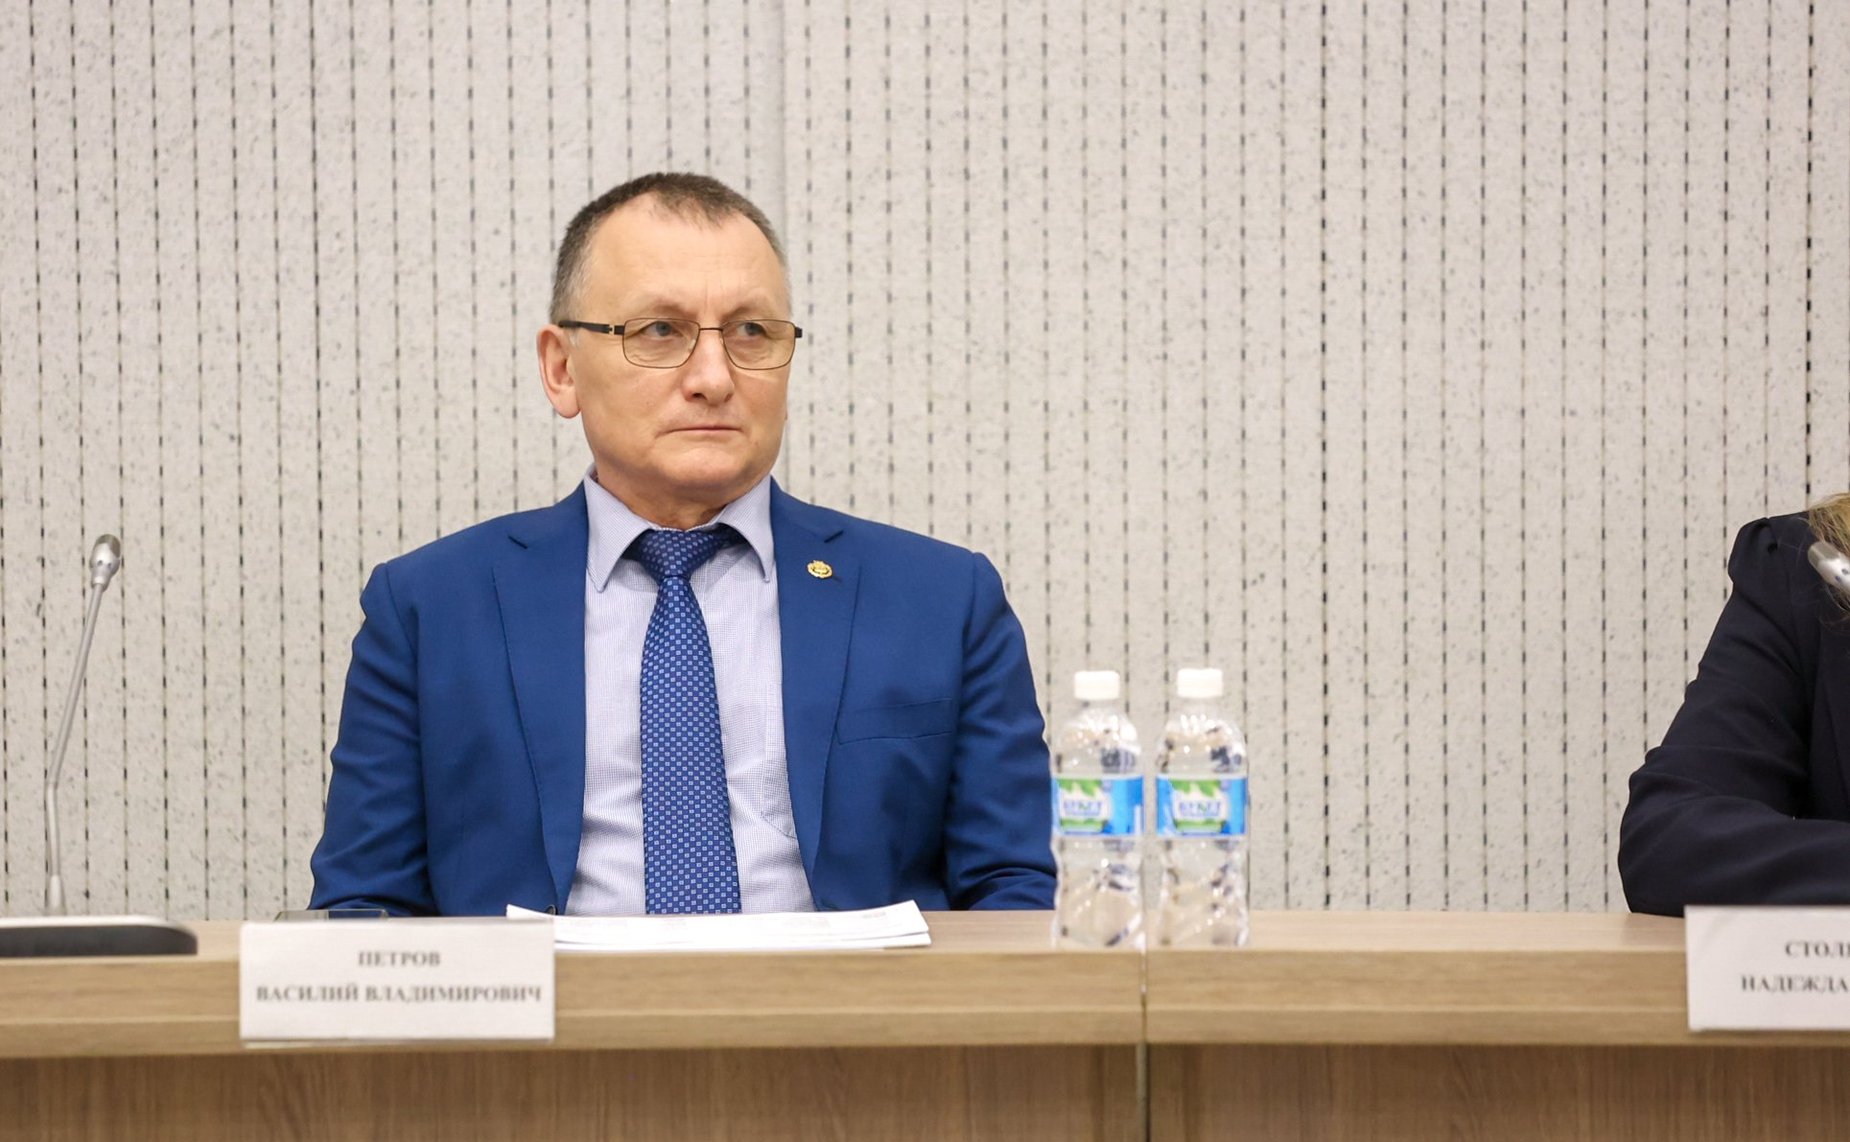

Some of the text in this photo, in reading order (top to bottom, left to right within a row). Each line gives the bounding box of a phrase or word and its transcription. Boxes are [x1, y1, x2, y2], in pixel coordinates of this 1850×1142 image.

[1784, 941, 1850, 958] СТОЛ
[357, 951, 441, 967] ПЕТРОВ
[256, 983, 541, 1003] ВАСИЛИЙ ВЛАДИМИРОВИЧ
[1740, 975, 1850, 994] НАДЕЖДА
